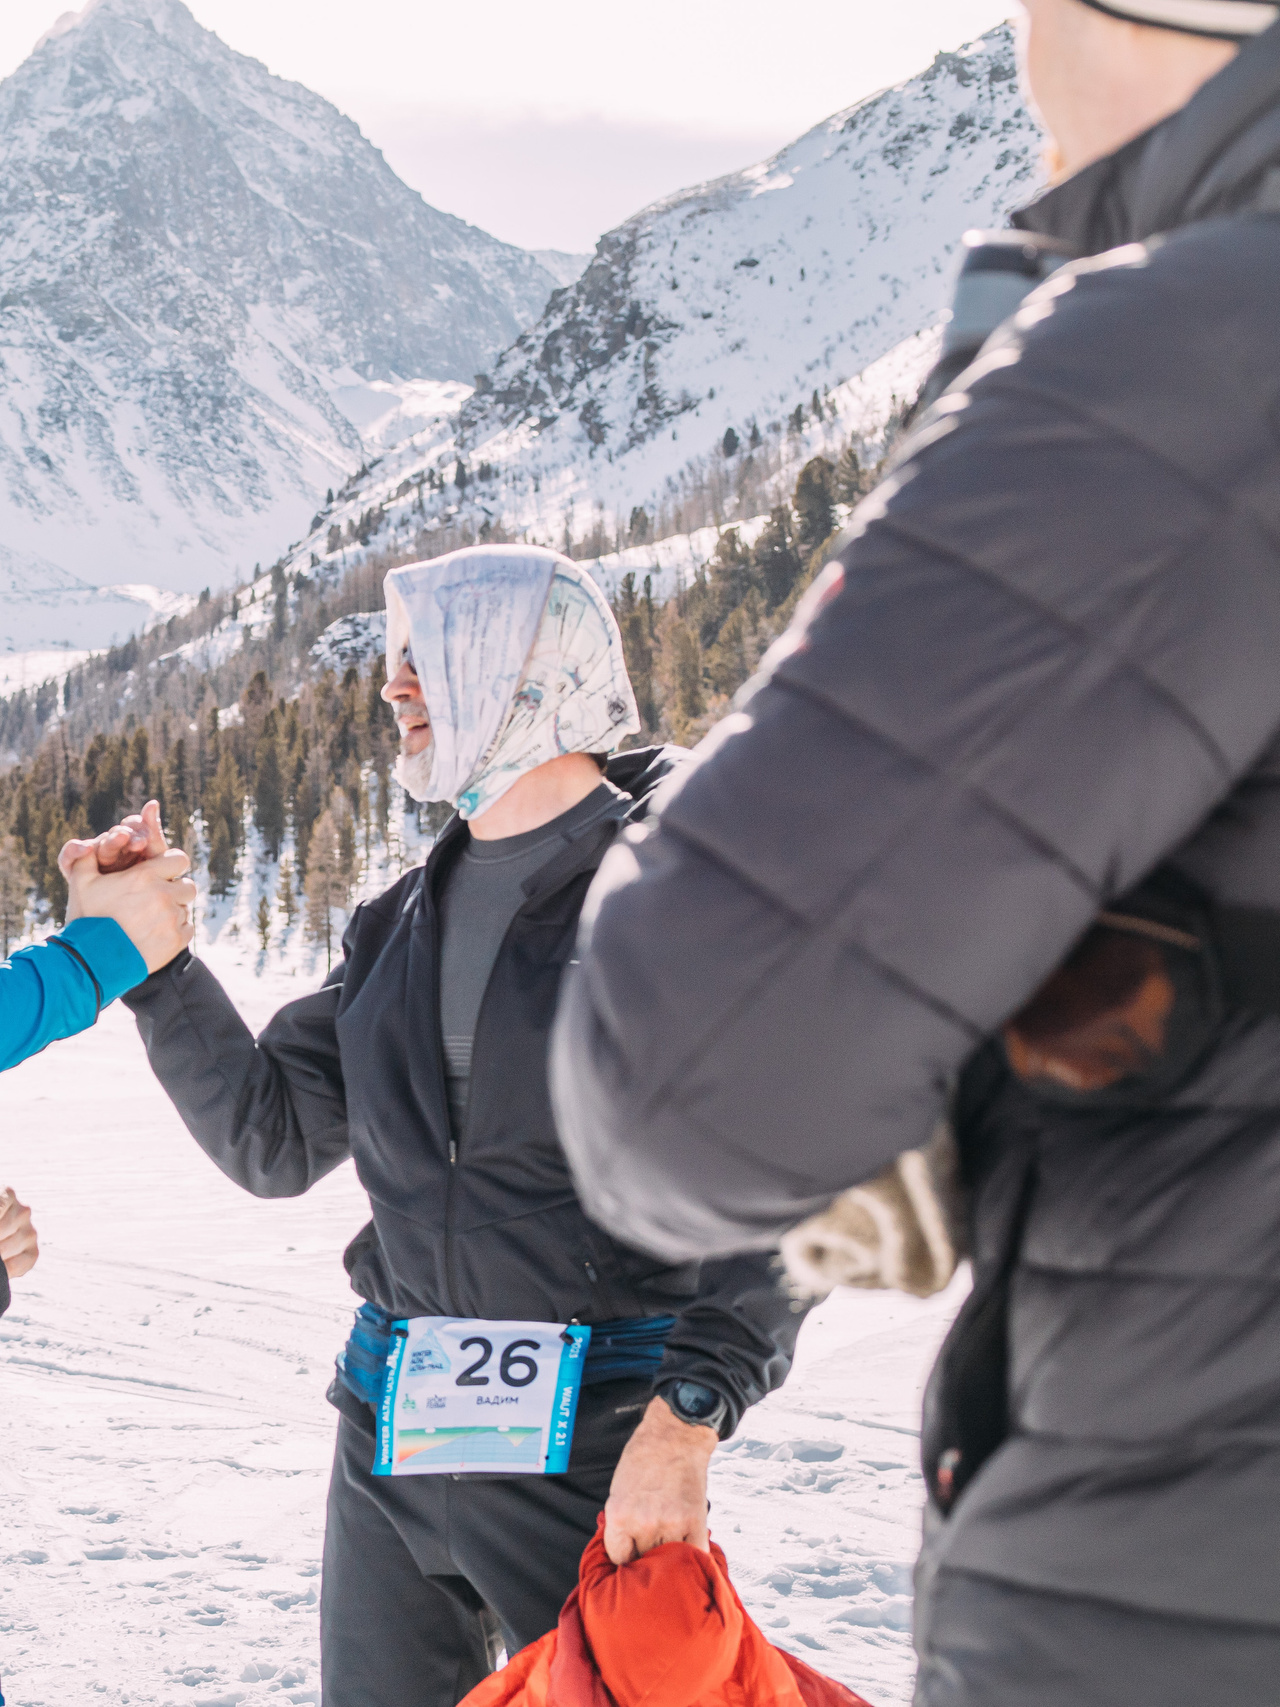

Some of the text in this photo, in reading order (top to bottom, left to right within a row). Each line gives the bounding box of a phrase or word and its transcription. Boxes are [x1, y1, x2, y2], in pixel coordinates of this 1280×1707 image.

[455, 1336, 541, 1388] 26
[382, 1394, 392, 1423] ALTAI
[476, 1395, 519, 1406] ВАДИМ
[559, 1386, 573, 1417] WAUT
[557, 1420, 568, 1429] X
[380, 1425, 390, 1466] WINTER
